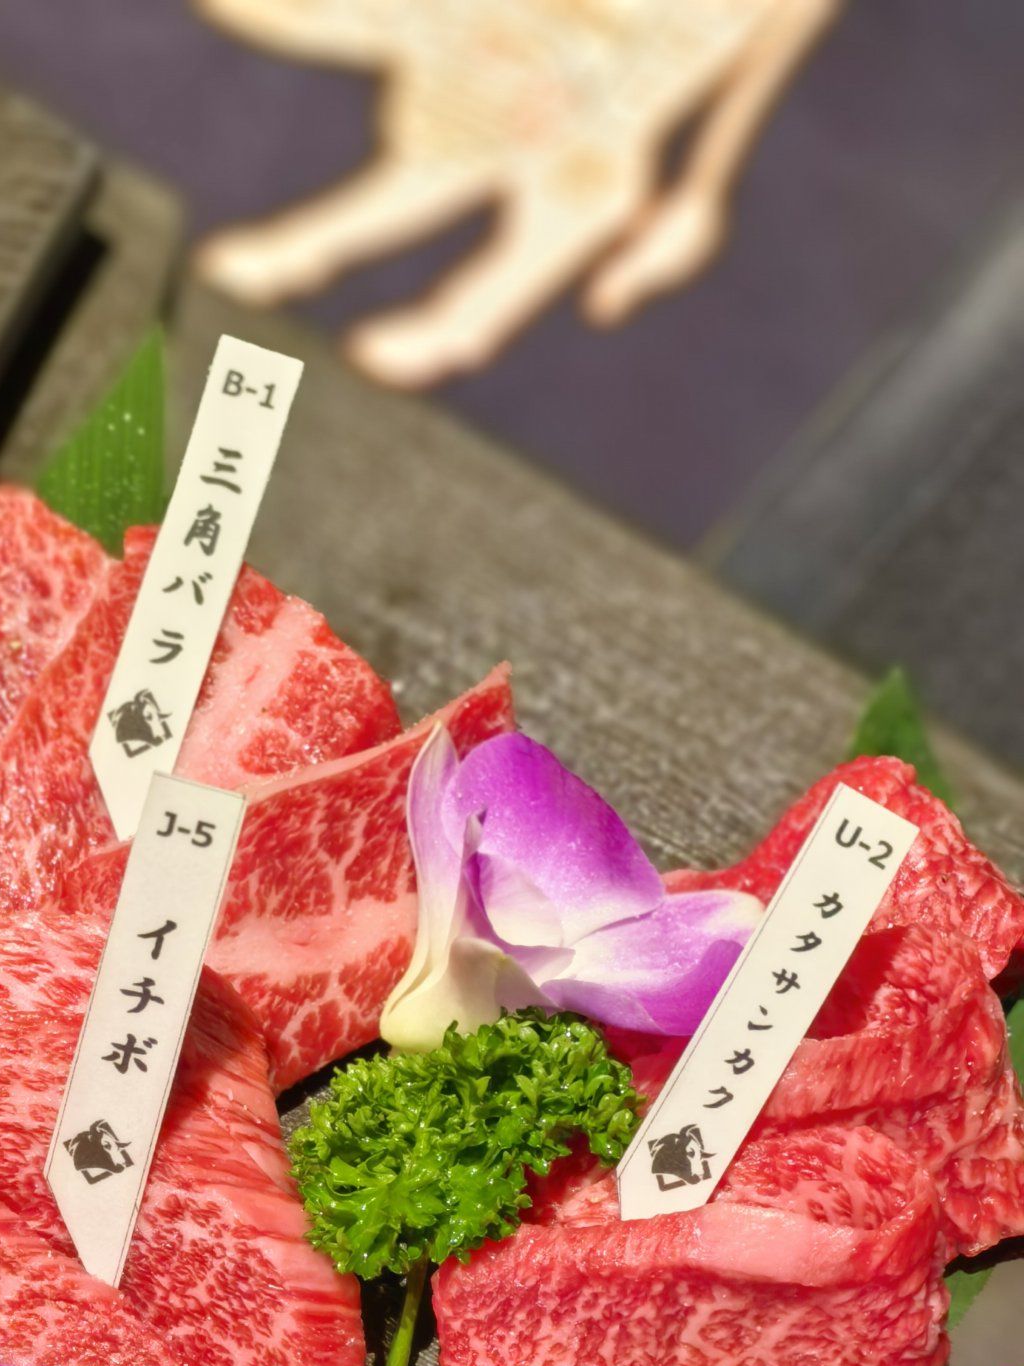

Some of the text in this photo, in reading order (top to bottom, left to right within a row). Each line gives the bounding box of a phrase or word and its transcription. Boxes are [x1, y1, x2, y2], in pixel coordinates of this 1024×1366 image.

[222, 369, 276, 410] B-1
[149, 446, 243, 665] 三角バラ
[156, 810, 216, 849] J-5
[834, 818, 895, 870] U-2
[101, 919, 178, 1075] イチボ
[703, 892, 844, 1109] カタサンカク
